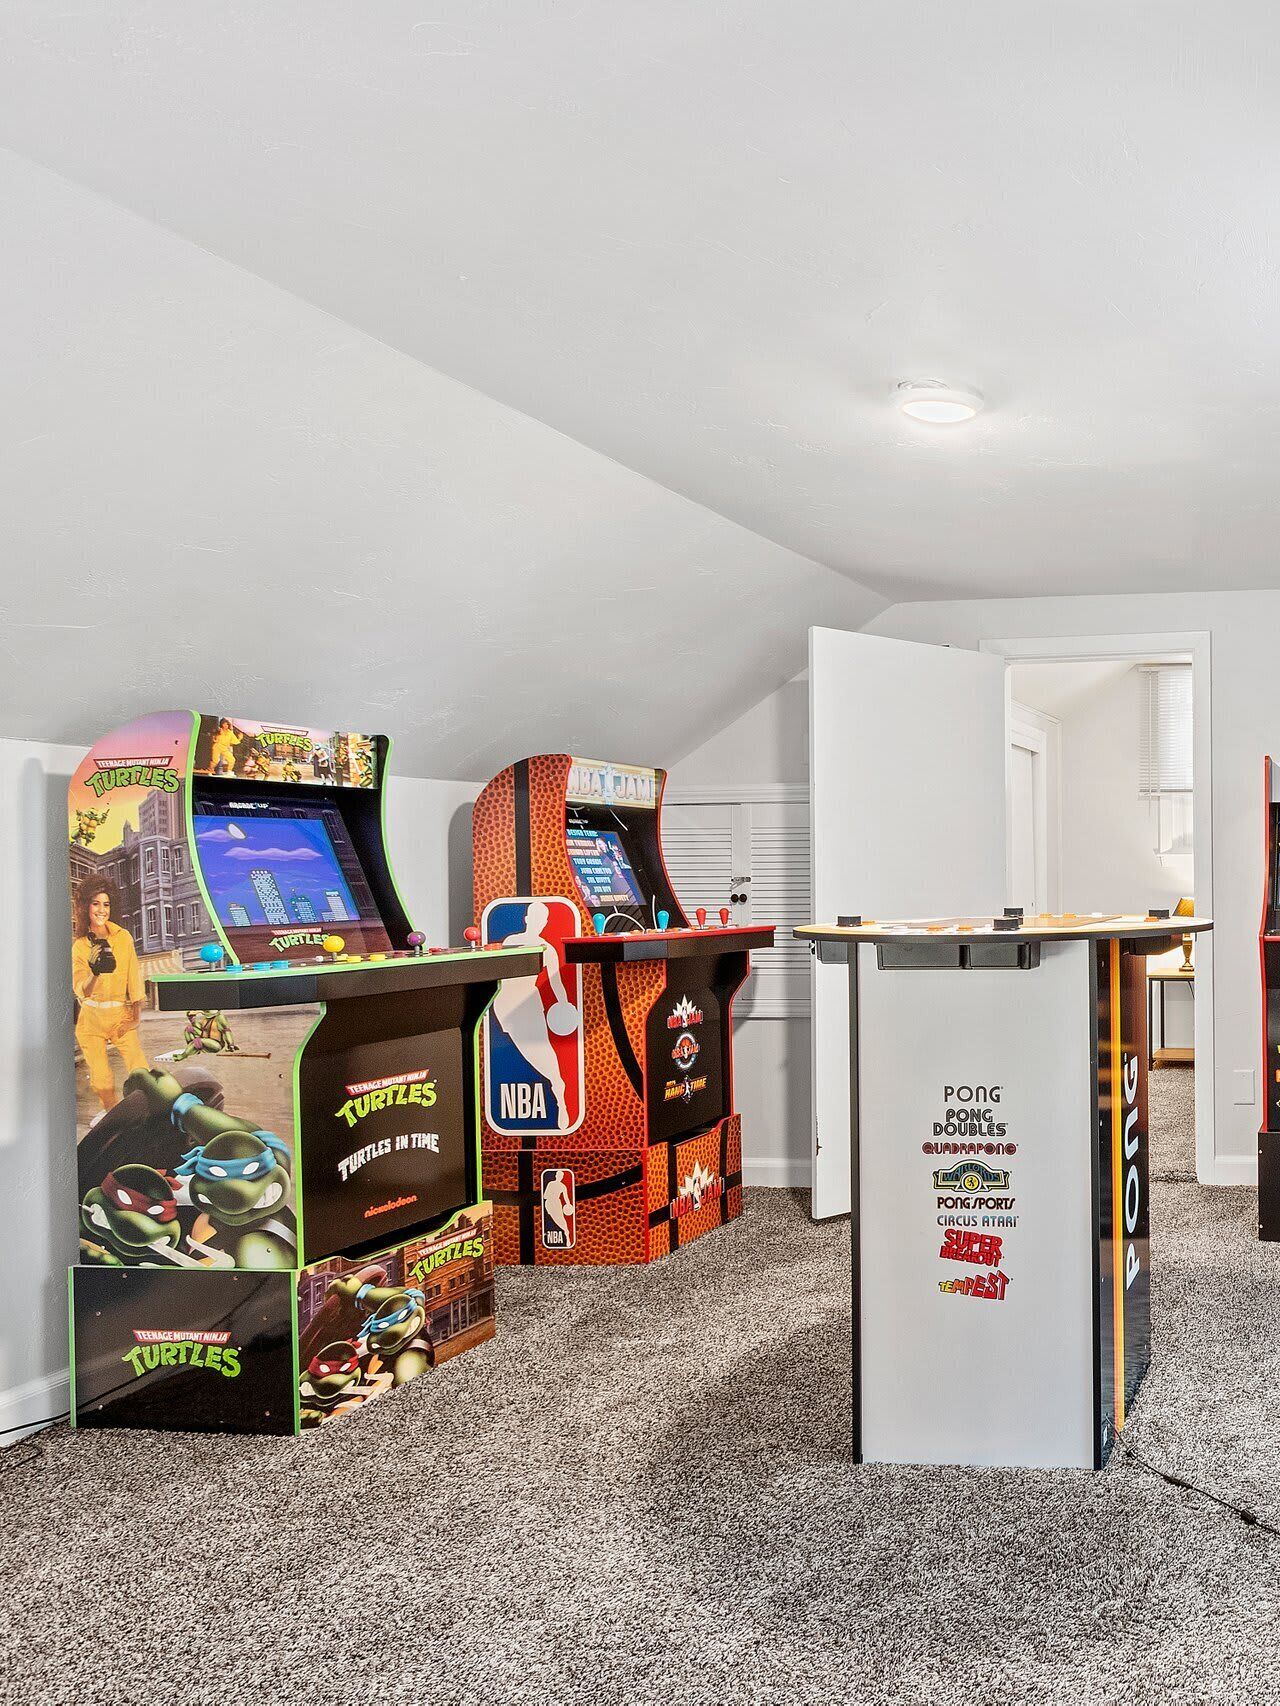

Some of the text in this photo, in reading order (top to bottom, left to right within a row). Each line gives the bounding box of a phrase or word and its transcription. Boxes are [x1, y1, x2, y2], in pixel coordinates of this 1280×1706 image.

[255, 732, 313, 752] TURTLES
[96, 759, 126, 767] TEENAGE
[127, 758, 150, 766] MUTANT
[84, 766, 180, 797] TURTLES
[566, 766, 652, 800] NBA JAM
[348, 1072, 426, 1093] TEENAGE MUTANT NINJA
[335, 1082, 437, 1128] TURTLES
[500, 1083, 547, 1119] NBA
[944, 1086, 1000, 1103] PONG
[946, 1108, 993, 1122] PONG
[933, 1122, 1006, 1136] DOUBLES
[338, 1133, 439, 1182] TURTLES IN TIME
[922, 1142, 1017, 1155] QUADRAPONG
[1124, 1056, 1140, 1290] PONG
[364, 1195, 417, 1218] nickelodeon
[937, 1197, 1015, 1210] PONG SPORTS
[937, 1215, 1016, 1227] CIRCUS ATARI
[547, 1231, 563, 1244] NBA
[944, 1229, 1003, 1255] SUPER
[409, 1237, 484, 1283] TURTLES
[940, 1246, 1002, 1267] BREAKOUT
[938, 1270, 1009, 1300] TEMPEST
[136, 1331, 228, 1341] TEENAGE MUTANT NINJA
[121, 1341, 241, 1377] TURTLES
